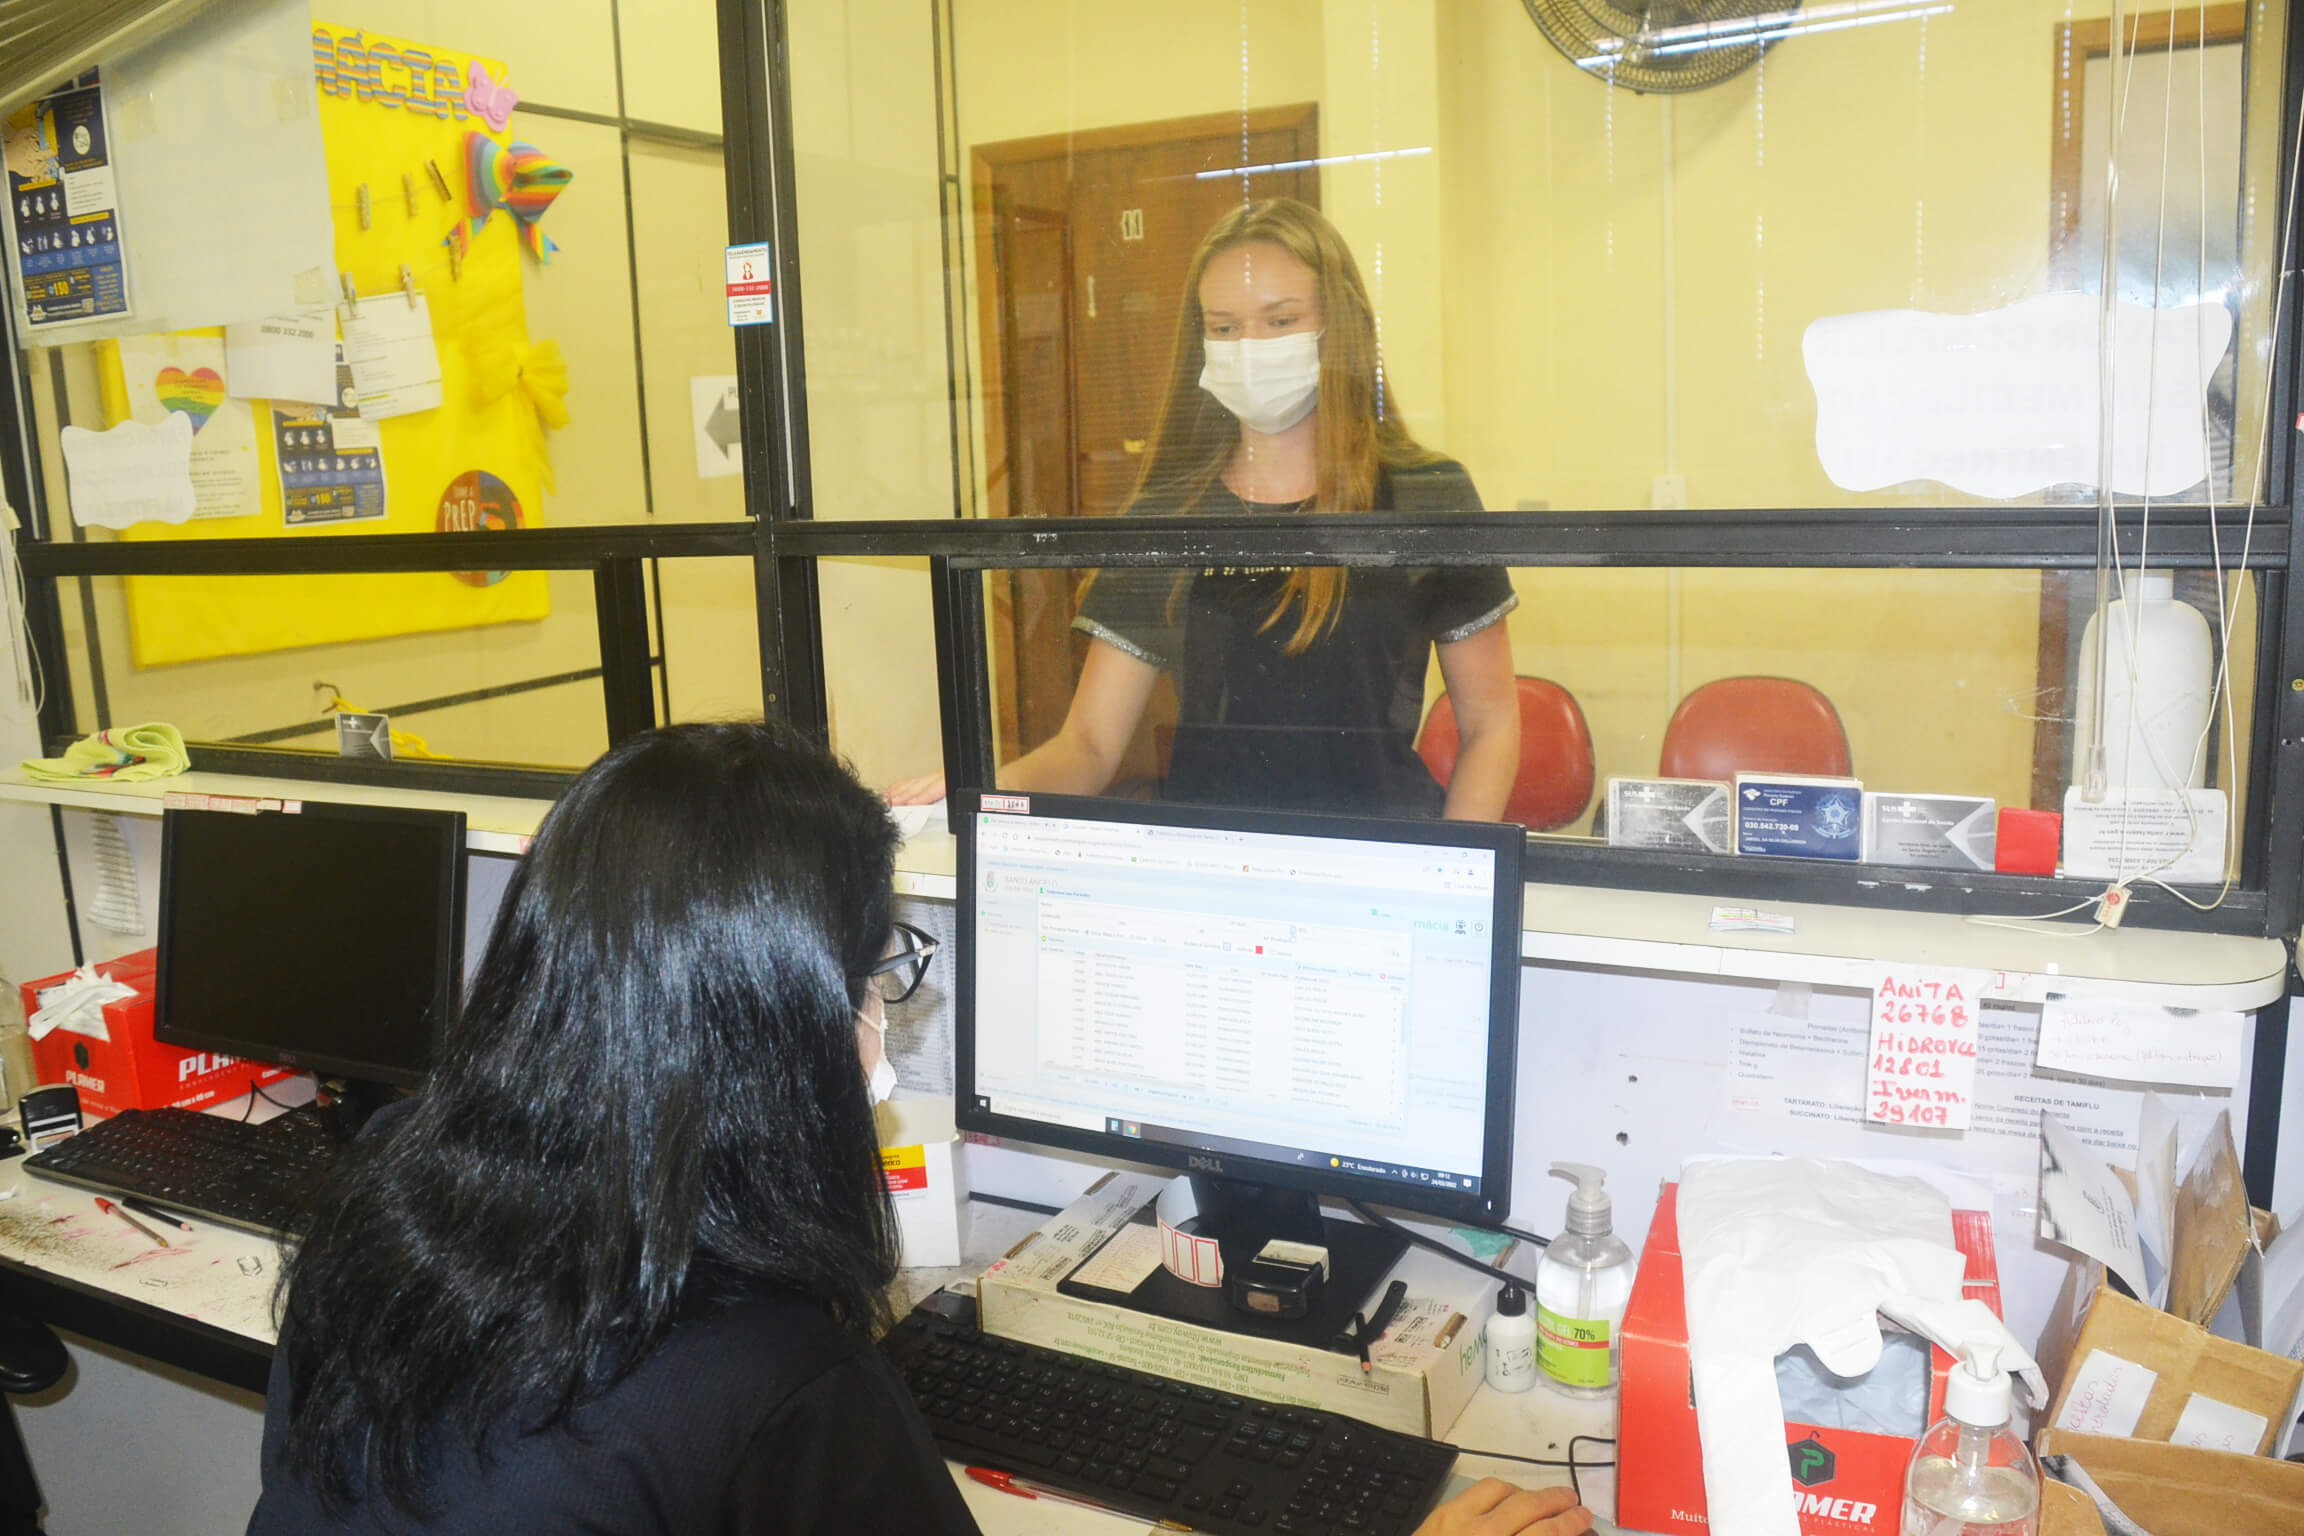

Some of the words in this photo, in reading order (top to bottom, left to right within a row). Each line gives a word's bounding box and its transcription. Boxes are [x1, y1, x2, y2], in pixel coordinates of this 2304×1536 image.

[1769, 798, 1789, 807] CPF
[2014, 1095, 2052, 1105] RECEITAS
[2053, 1098, 2065, 1107] DE
[2066, 1099, 2100, 1111] TAMIFLU
[1188, 1155, 1224, 1173] DELL
[1574, 1327, 1596, 1340] 70%
